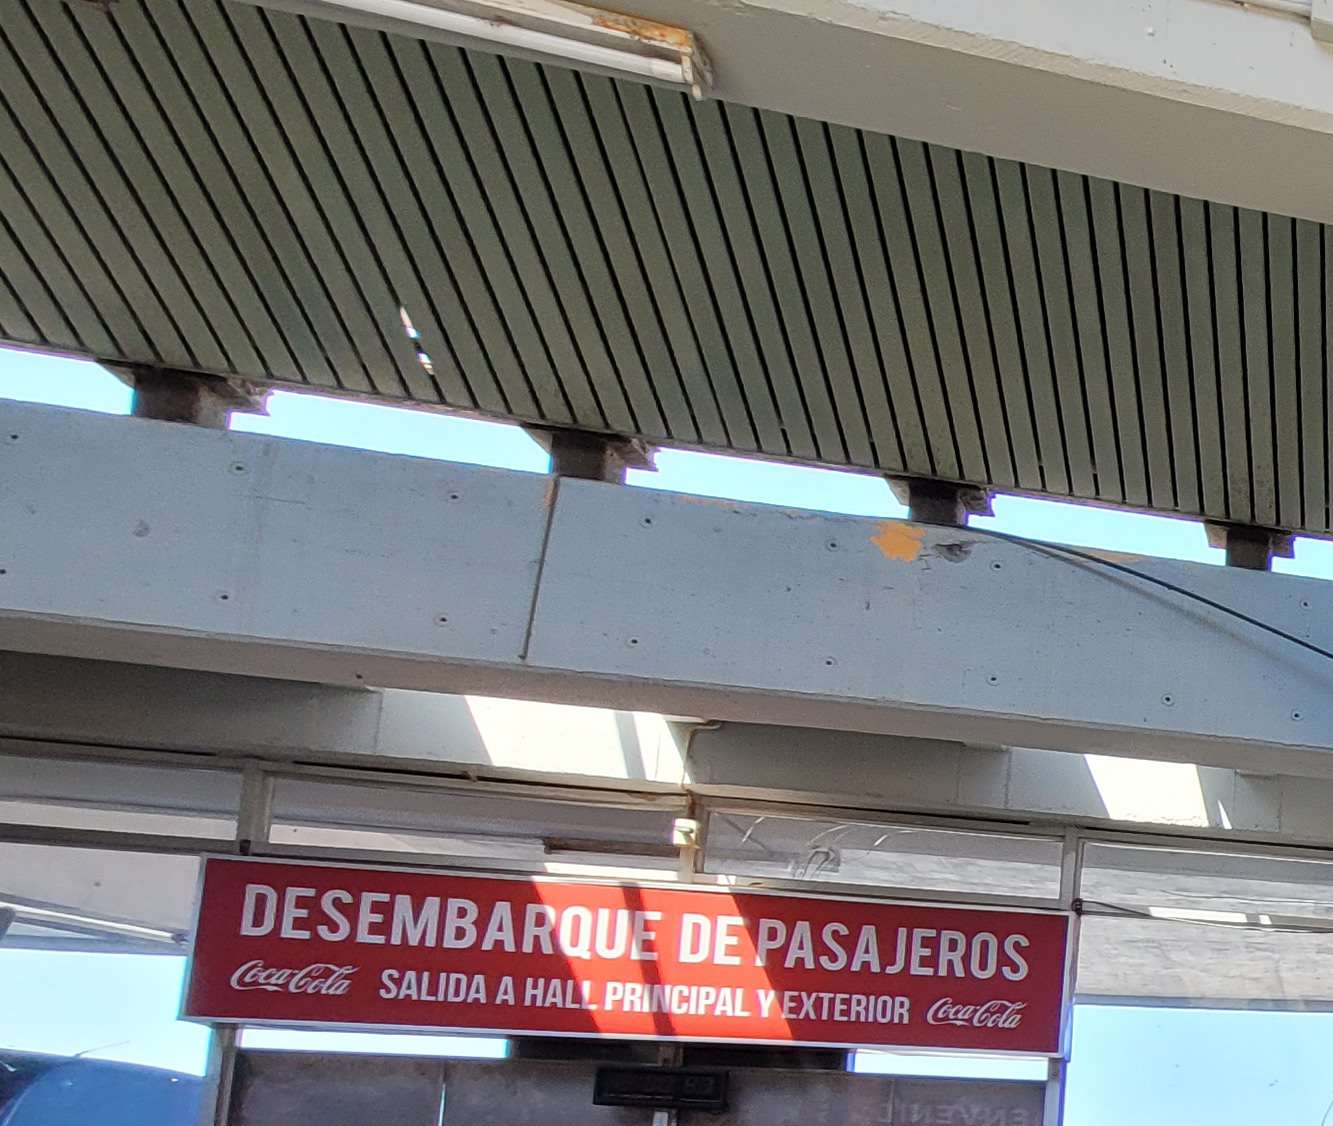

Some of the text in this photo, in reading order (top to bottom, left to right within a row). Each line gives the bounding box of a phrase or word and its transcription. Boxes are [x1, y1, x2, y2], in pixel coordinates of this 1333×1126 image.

[240, 883, 1031, 982] DESEMBARQUE DE PASAJEROS
[229, 959, 360, 995] Coca-Cola
[379, 969, 911, 1025] SALIDA A HALL PRINCIPAL Y EXTERIOR
[926, 997, 1027, 1030] Coca-Cola
